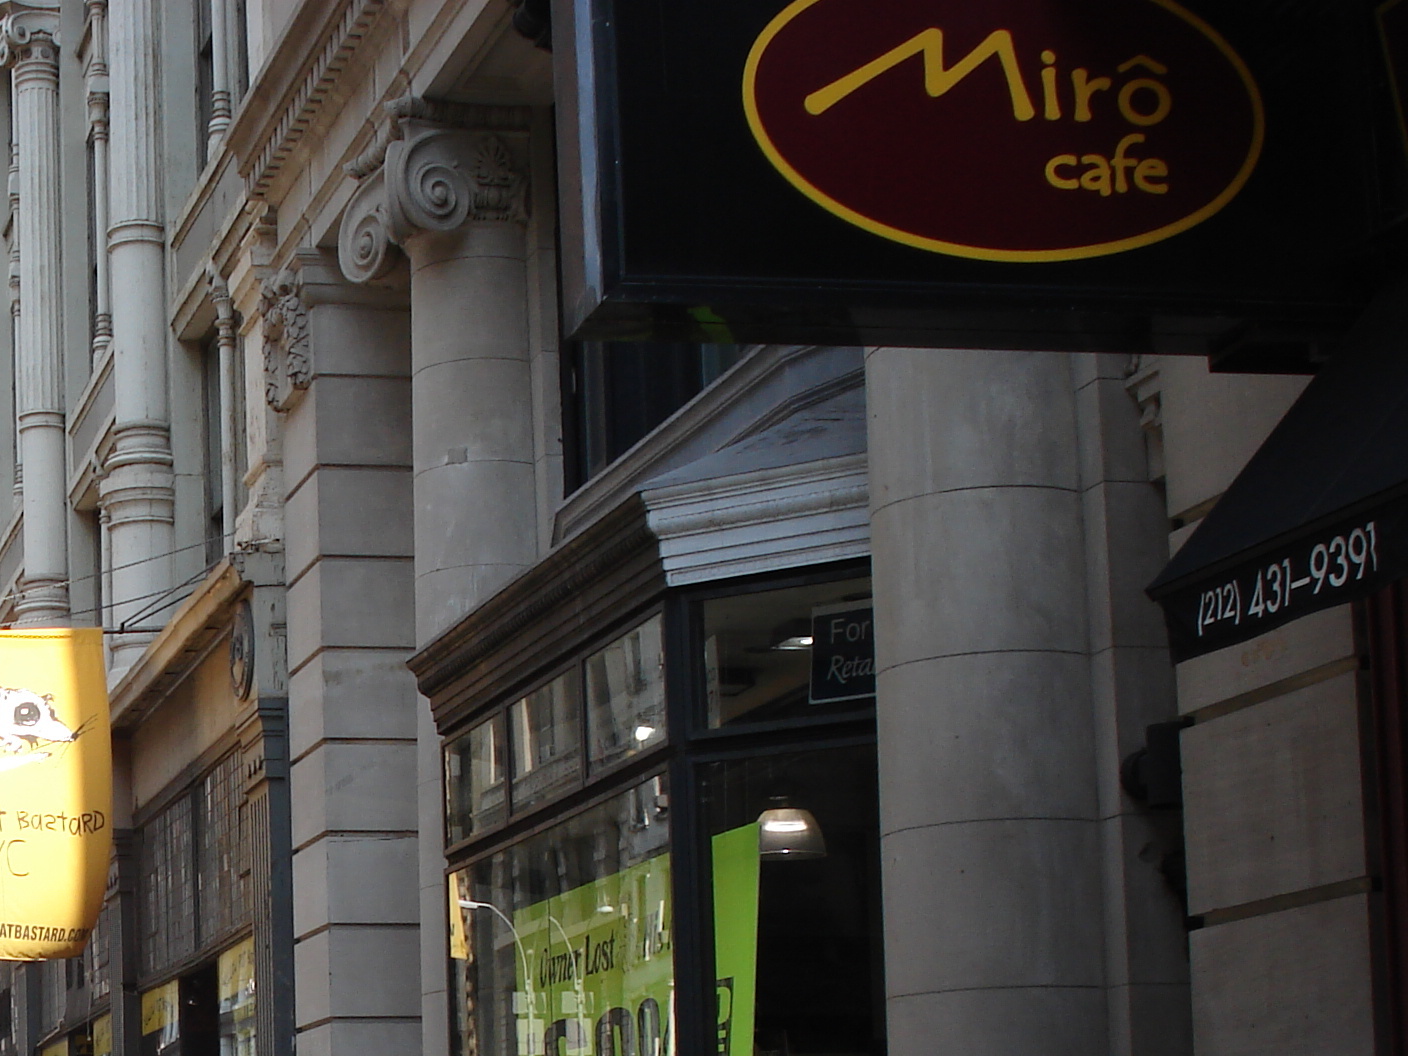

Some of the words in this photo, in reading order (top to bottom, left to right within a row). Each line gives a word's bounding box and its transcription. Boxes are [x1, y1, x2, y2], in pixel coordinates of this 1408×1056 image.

[1044, 132, 1170, 197] cafe
[1197, 579, 1240, 637] (212)
[1247, 521, 1378, 618] 431-9391
[831, 618, 871, 645] For
[827, 655, 876, 684] Reta
[585, 928, 615, 976] Lost
